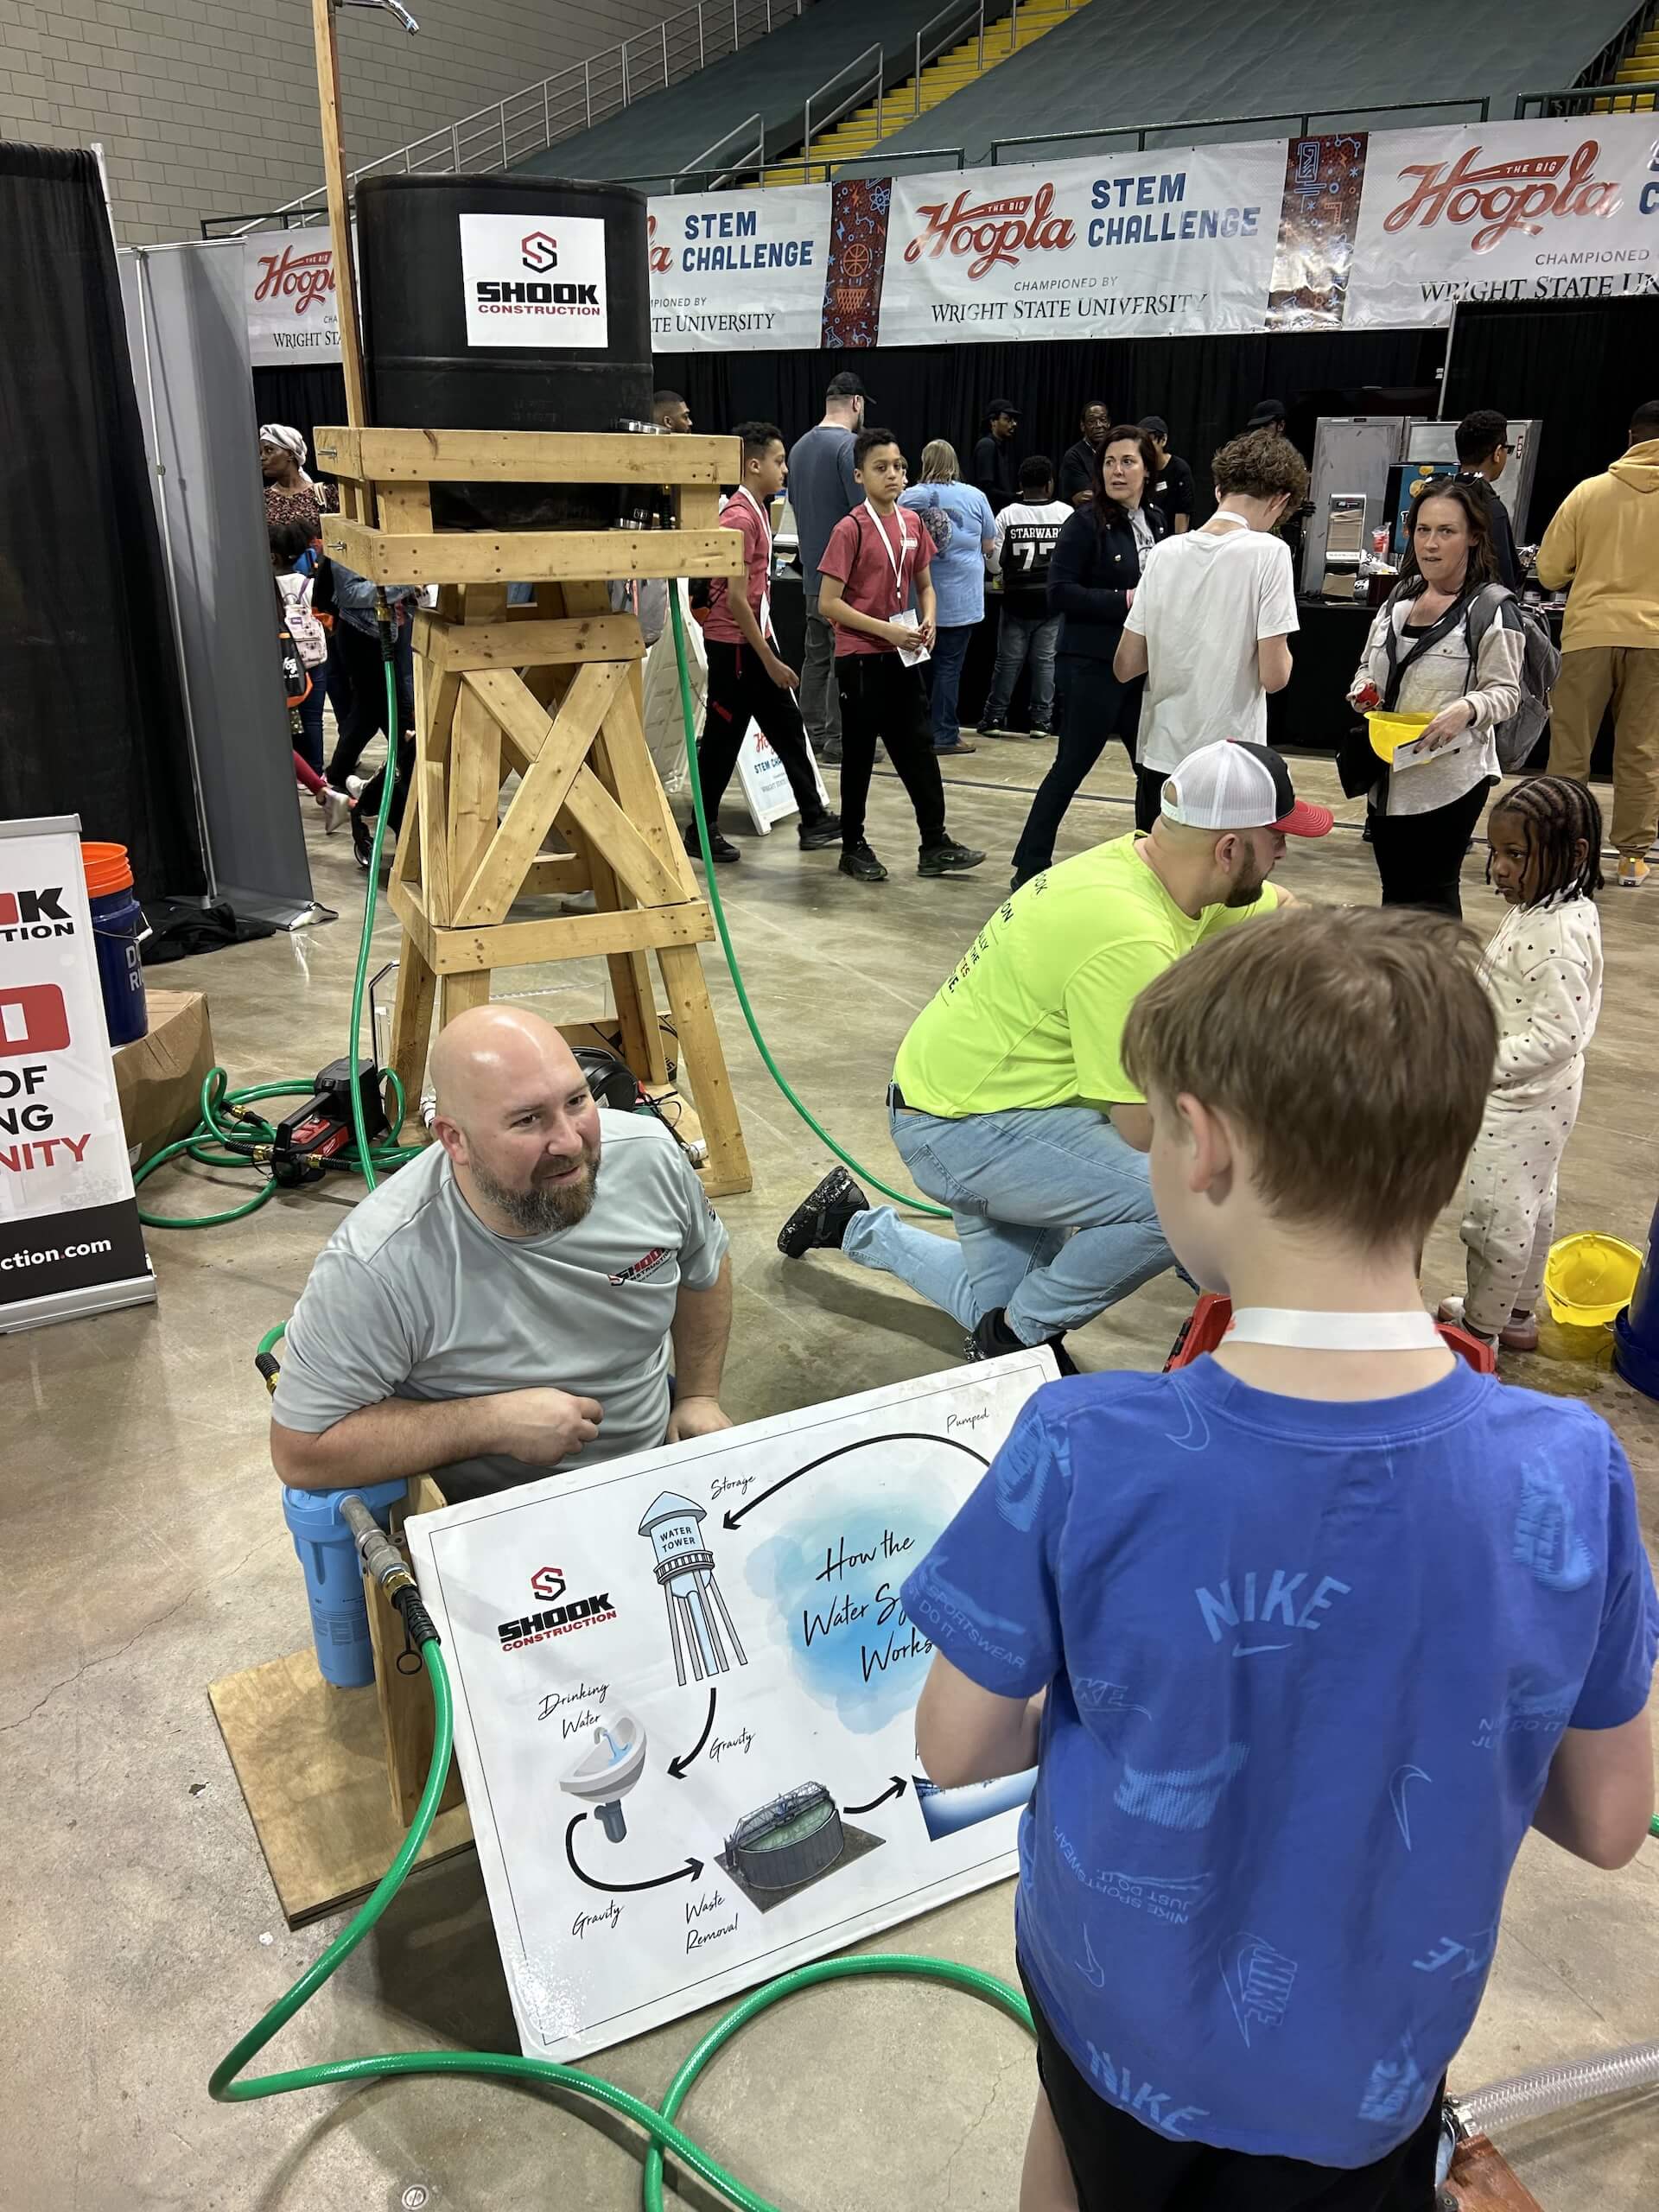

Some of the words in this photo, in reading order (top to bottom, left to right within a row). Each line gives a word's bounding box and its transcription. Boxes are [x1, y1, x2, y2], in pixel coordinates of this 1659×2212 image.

[1506, 164, 1529, 175] THE
[1535, 162, 1556, 173] BIG
[1090, 172, 1186, 210] STEM
[1382, 139, 1624, 254] Hoopla
[988, 203, 1006, 213] THE
[684, 210, 757, 239] STEM
[904, 182, 1078, 281] Hoopla
[1088, 207, 1262, 248] CHALLENGE
[683, 240, 814, 272] CHALLENGE
[1535, 249, 1649, 266] CHAMPIONED
[477, 281, 600, 305] SHOOK
[1014, 276, 1098, 292] CHAMPIONED
[1102, 276, 1119, 289] BY
[1535, 276, 1614, 300] STATE
[478, 304, 601, 316] CONSTRUCTION
[694, 296, 707, 307] BY
[931, 302, 1007, 325] WRIGHT
[1014, 299, 1071, 320] STATE
[1077, 292, 1208, 317] UNIVERSITY
[676, 313, 776, 334] UNIVERSITY
[273, 332, 321, 349] WRIGHT
[946, 1407, 990, 1433] Pumped
[710, 1475, 756, 1500] Storage
[659, 1526, 692, 1542] WATER
[662, 1536, 696, 1553] TOWER
[815, 1536, 877, 1582] How
[880, 1529, 915, 1558] the
[498, 1592, 615, 1643] SHOOK
[804, 1593, 869, 1647] Water
[918, 1601, 941, 1625] DO
[1195, 1569, 1352, 1643] NIKE
[502, 1610, 618, 1652] CONSTRUCTION
[925, 1585, 1027, 1669] SPORTSWEAR
[861, 1627, 934, 1683] Works
[537, 1682, 610, 1720] Drinking
[563, 1709, 601, 1739] Water
[709, 1727, 756, 1763] Gravity
[1118, 1878, 1143, 1897] DO
[1147, 1891, 1190, 1911] JUST
[572, 1898, 625, 1939] Gravity
[685, 1890, 726, 1924] Waste
[1147, 1903, 1189, 1924] NIKE
[685, 1912, 739, 1955] Removal
[1086, 2039, 1211, 2137] NIKE
